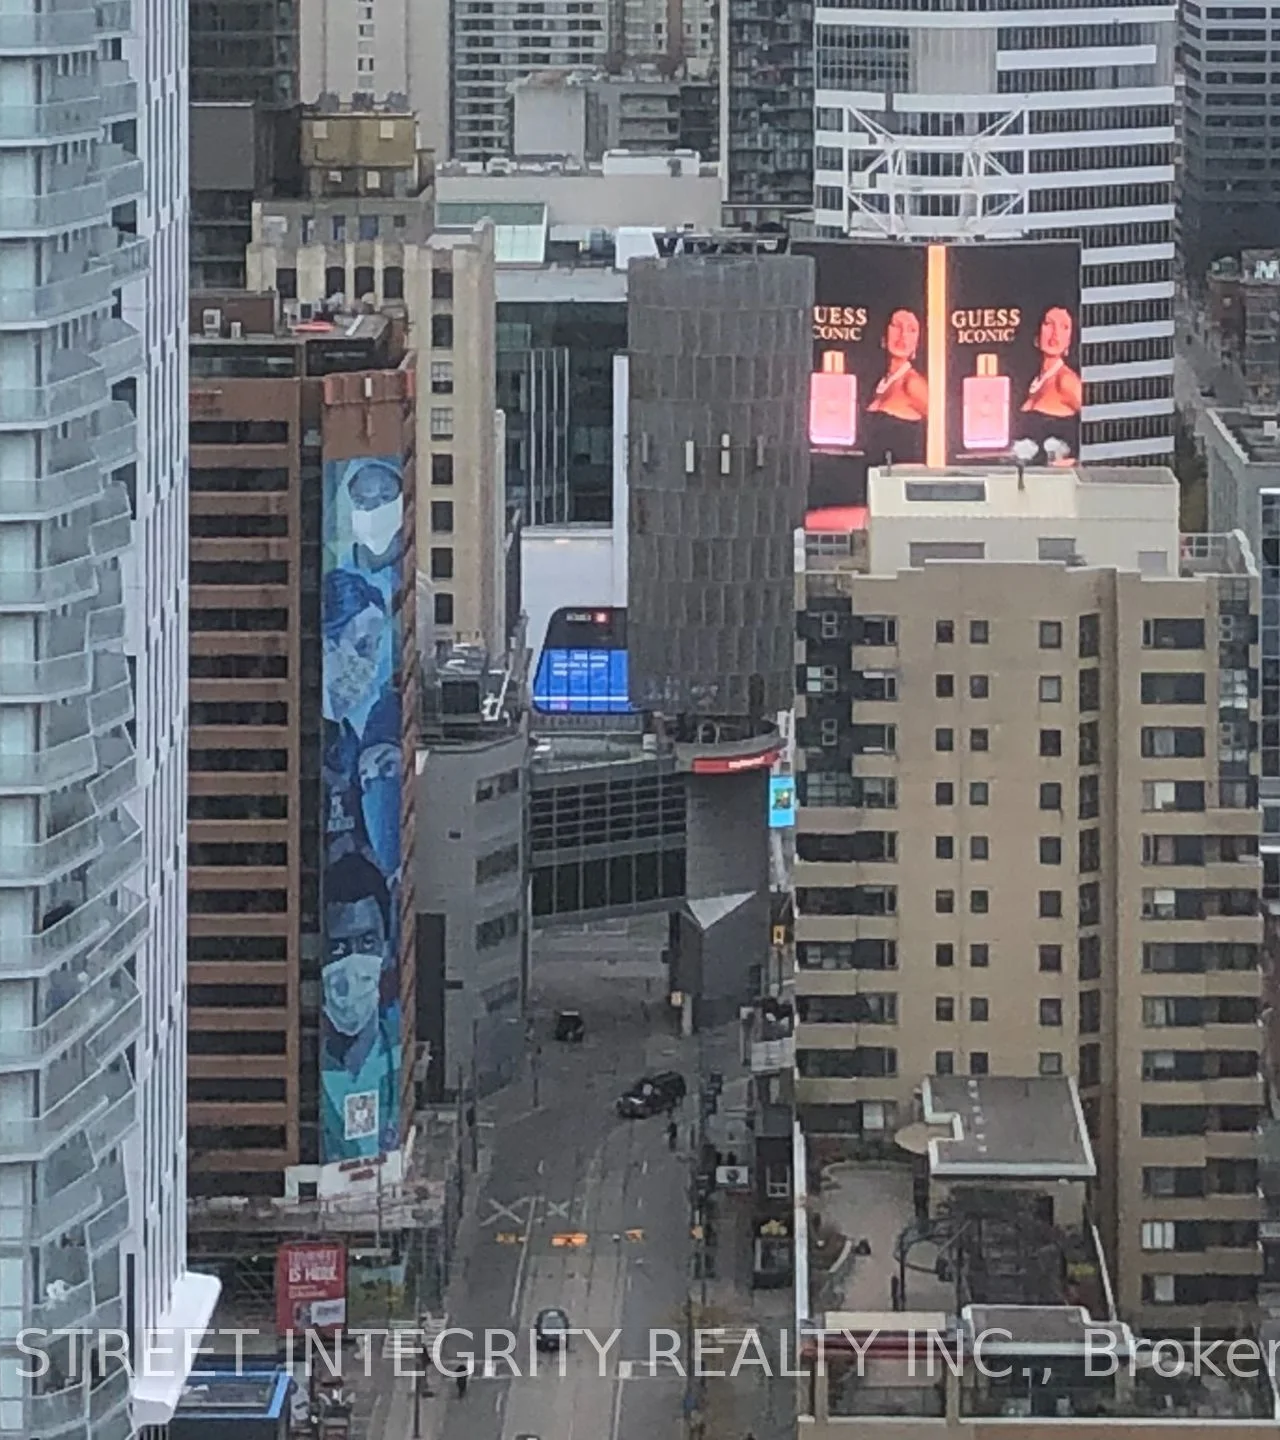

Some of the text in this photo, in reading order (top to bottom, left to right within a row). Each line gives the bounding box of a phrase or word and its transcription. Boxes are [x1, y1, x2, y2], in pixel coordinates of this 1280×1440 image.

[813, 306, 868, 326] UESS
[951, 308, 1021, 328] GUESS
[812, 326, 862, 341] CONIC
[957, 328, 1015, 344] ICONIC
